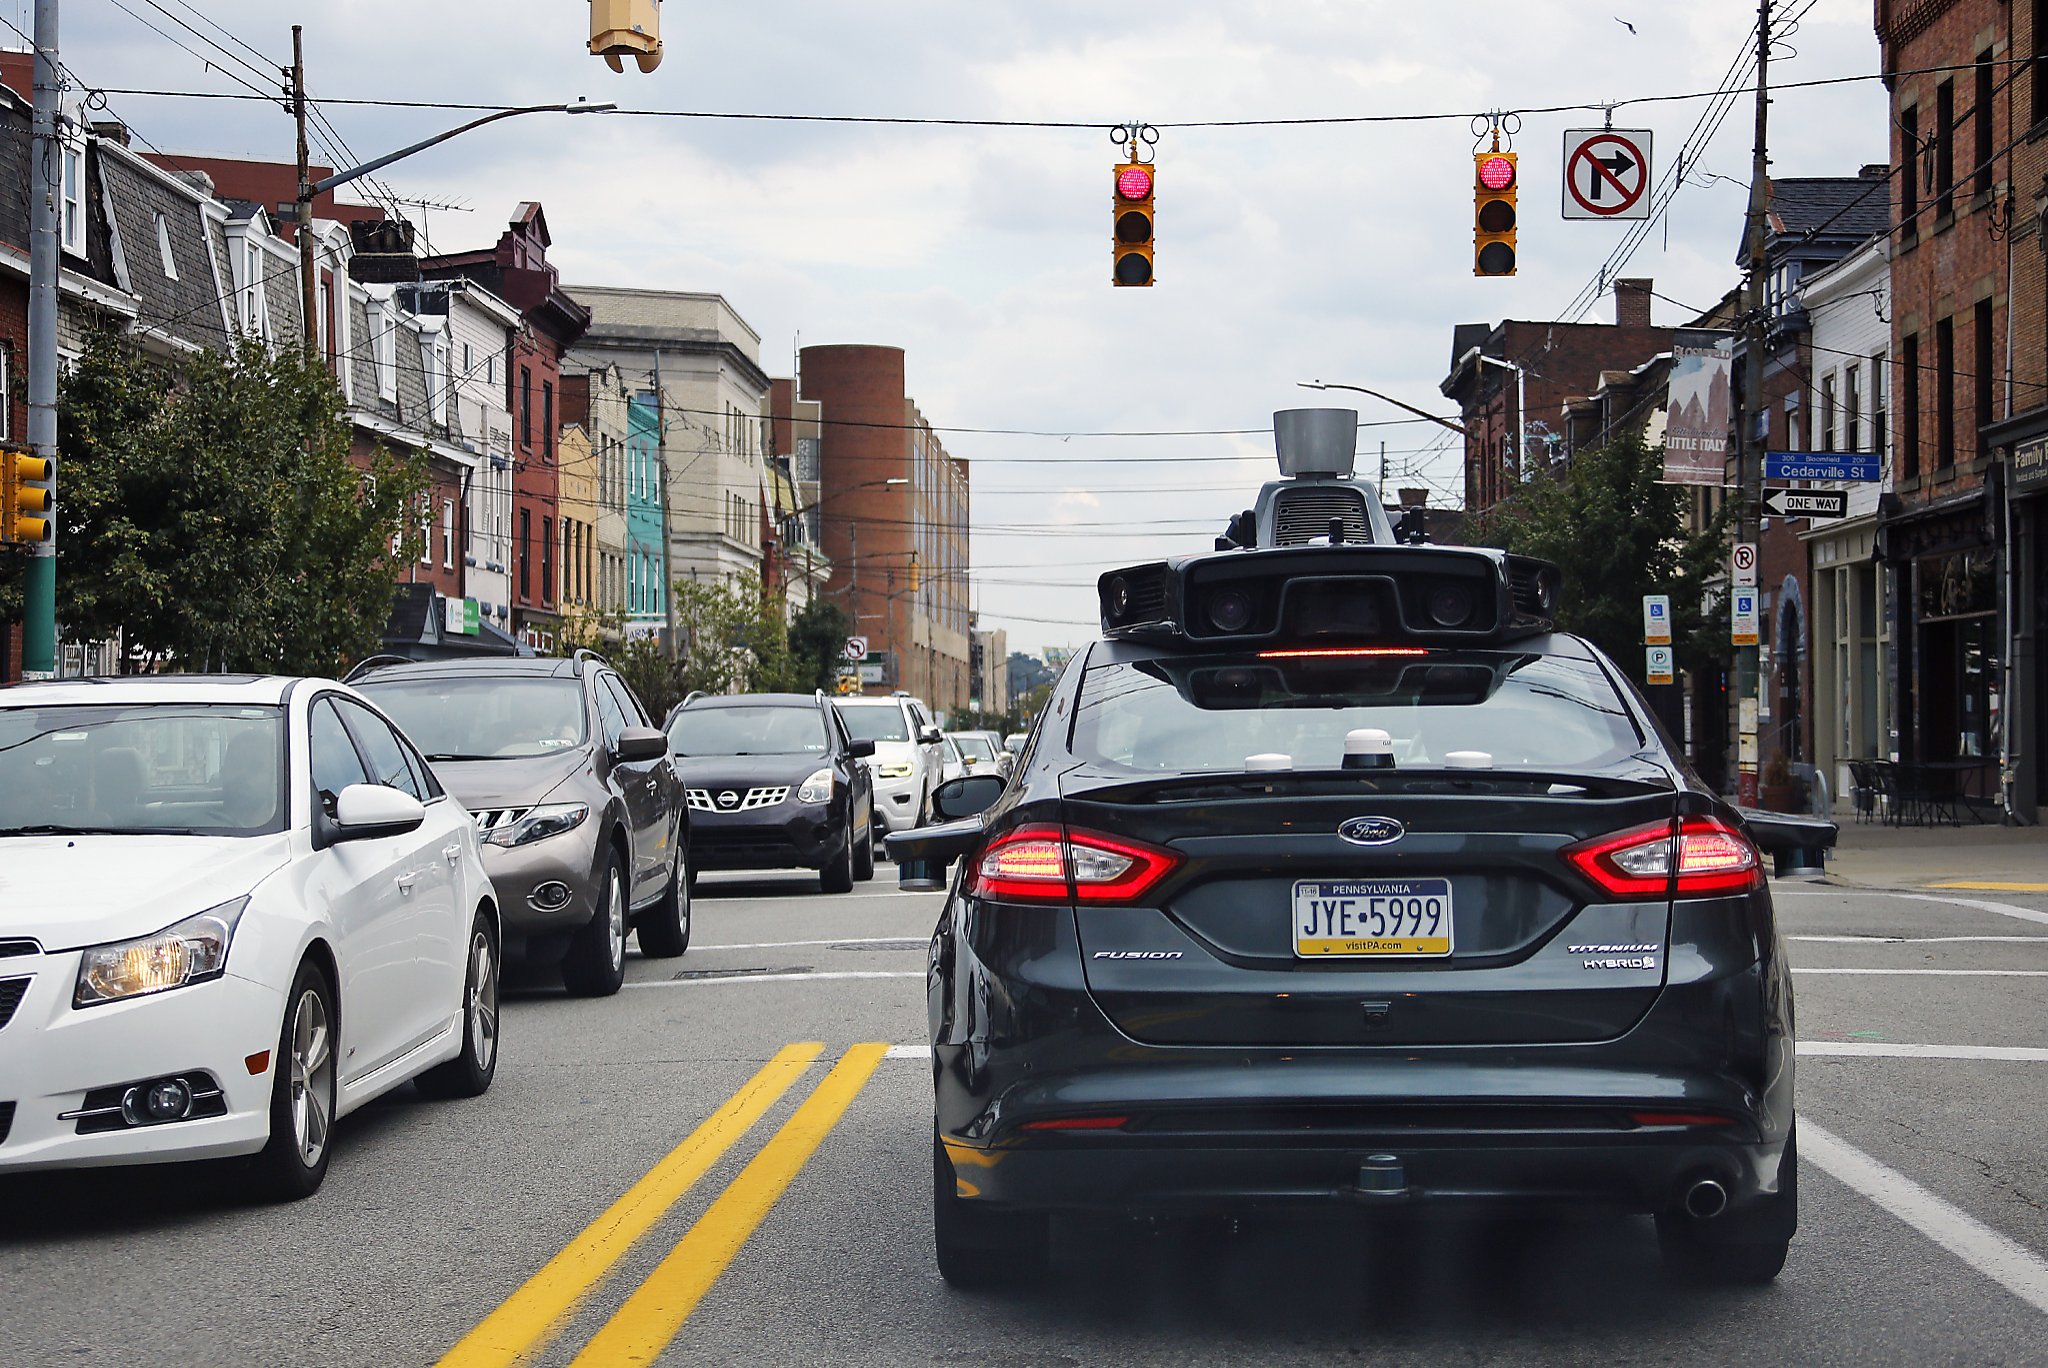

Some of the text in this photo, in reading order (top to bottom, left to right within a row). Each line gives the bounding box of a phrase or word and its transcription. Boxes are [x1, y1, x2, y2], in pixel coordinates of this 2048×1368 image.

[1666, 436, 1727, 452] LITTLE ITALY
[2014, 445, 2043, 469] Family
[1781, 465, 1865, 478] Cedarville St
[1787, 498, 1838, 510] ONE WAY
[1352, 822, 1390, 839] Ford
[1333, 884, 1410, 894] PENNSYLVANIA
[1346, 941, 1402, 950] visitPA.com
[1567, 944, 1658, 953] TITANIUM
[1093, 951, 1183, 960] FUSION
[1583, 959, 1642, 969] HYBRID
